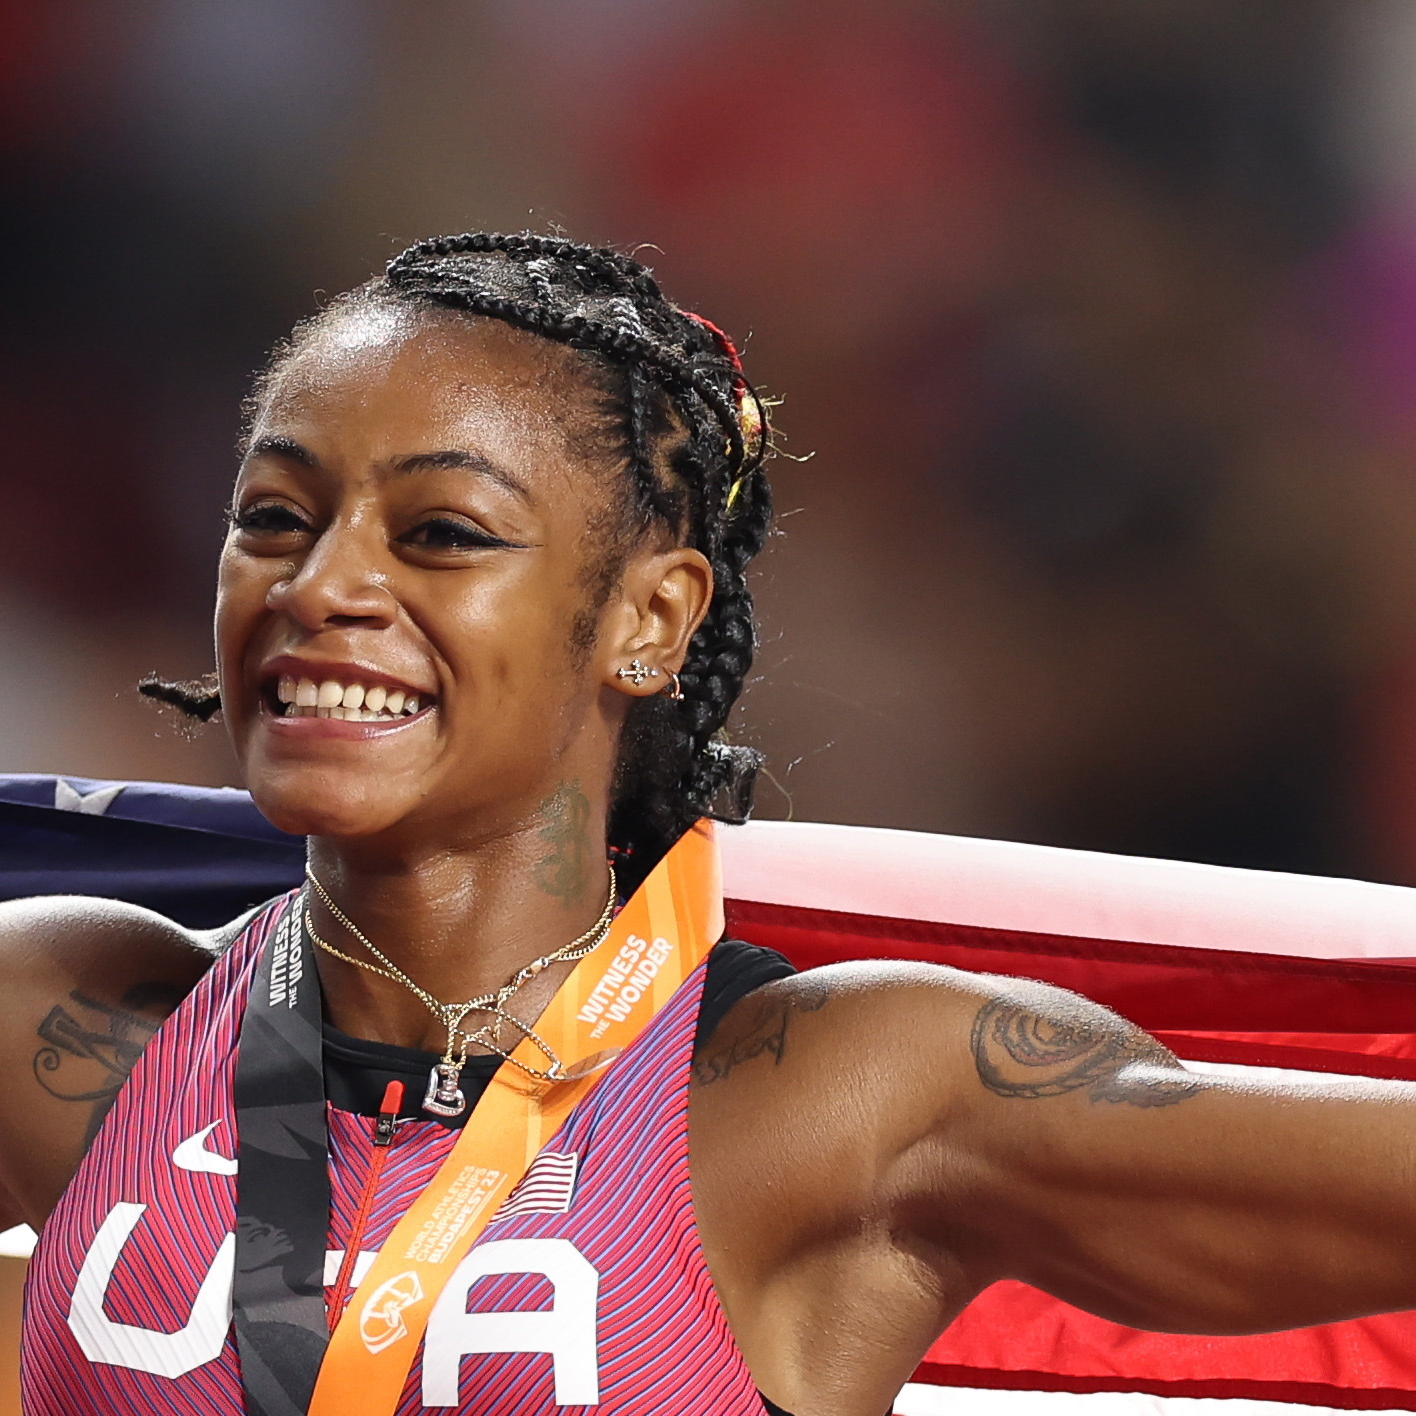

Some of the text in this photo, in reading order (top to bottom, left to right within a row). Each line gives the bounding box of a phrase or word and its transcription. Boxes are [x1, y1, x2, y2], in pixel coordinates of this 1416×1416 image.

[269, 914, 290, 1007] WITNESS
[288, 891, 306, 1009] THE WONDER
[576, 934, 648, 1024] WITNESS
[589, 936, 675, 1040] THE WONDER
[404, 1165, 475, 1259] WORLD ATHLETICS
[415, 1167, 487, 1262] CHAMPIONSHIPS
[427, 1169, 501, 1264] BUDAPEST 23
[67, 1201, 600, 1408] UA
